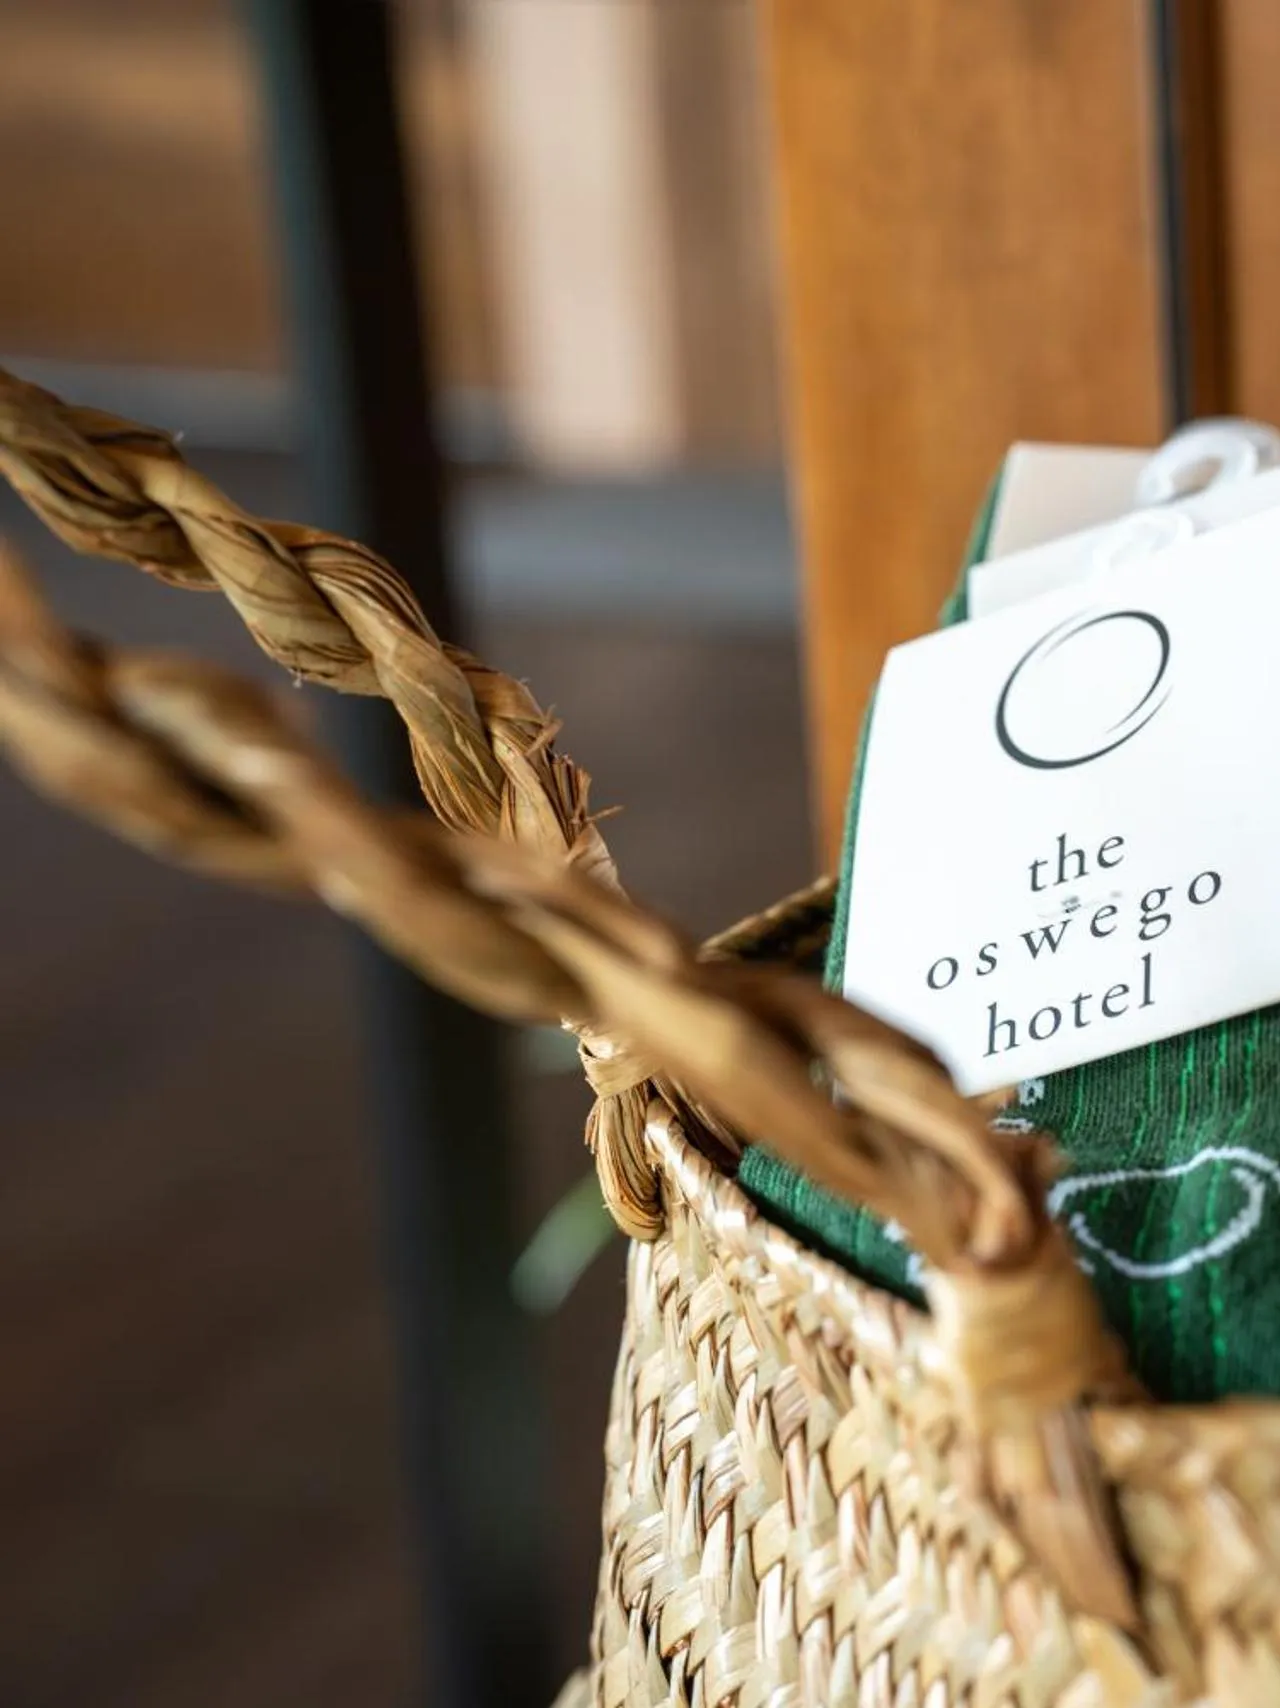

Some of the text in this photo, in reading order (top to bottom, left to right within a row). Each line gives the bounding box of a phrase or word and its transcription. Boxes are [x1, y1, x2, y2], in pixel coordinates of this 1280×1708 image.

[1028, 833, 1126, 893] the
[925, 869, 1223, 991] oswego
[981, 952, 1156, 1058] hotel
